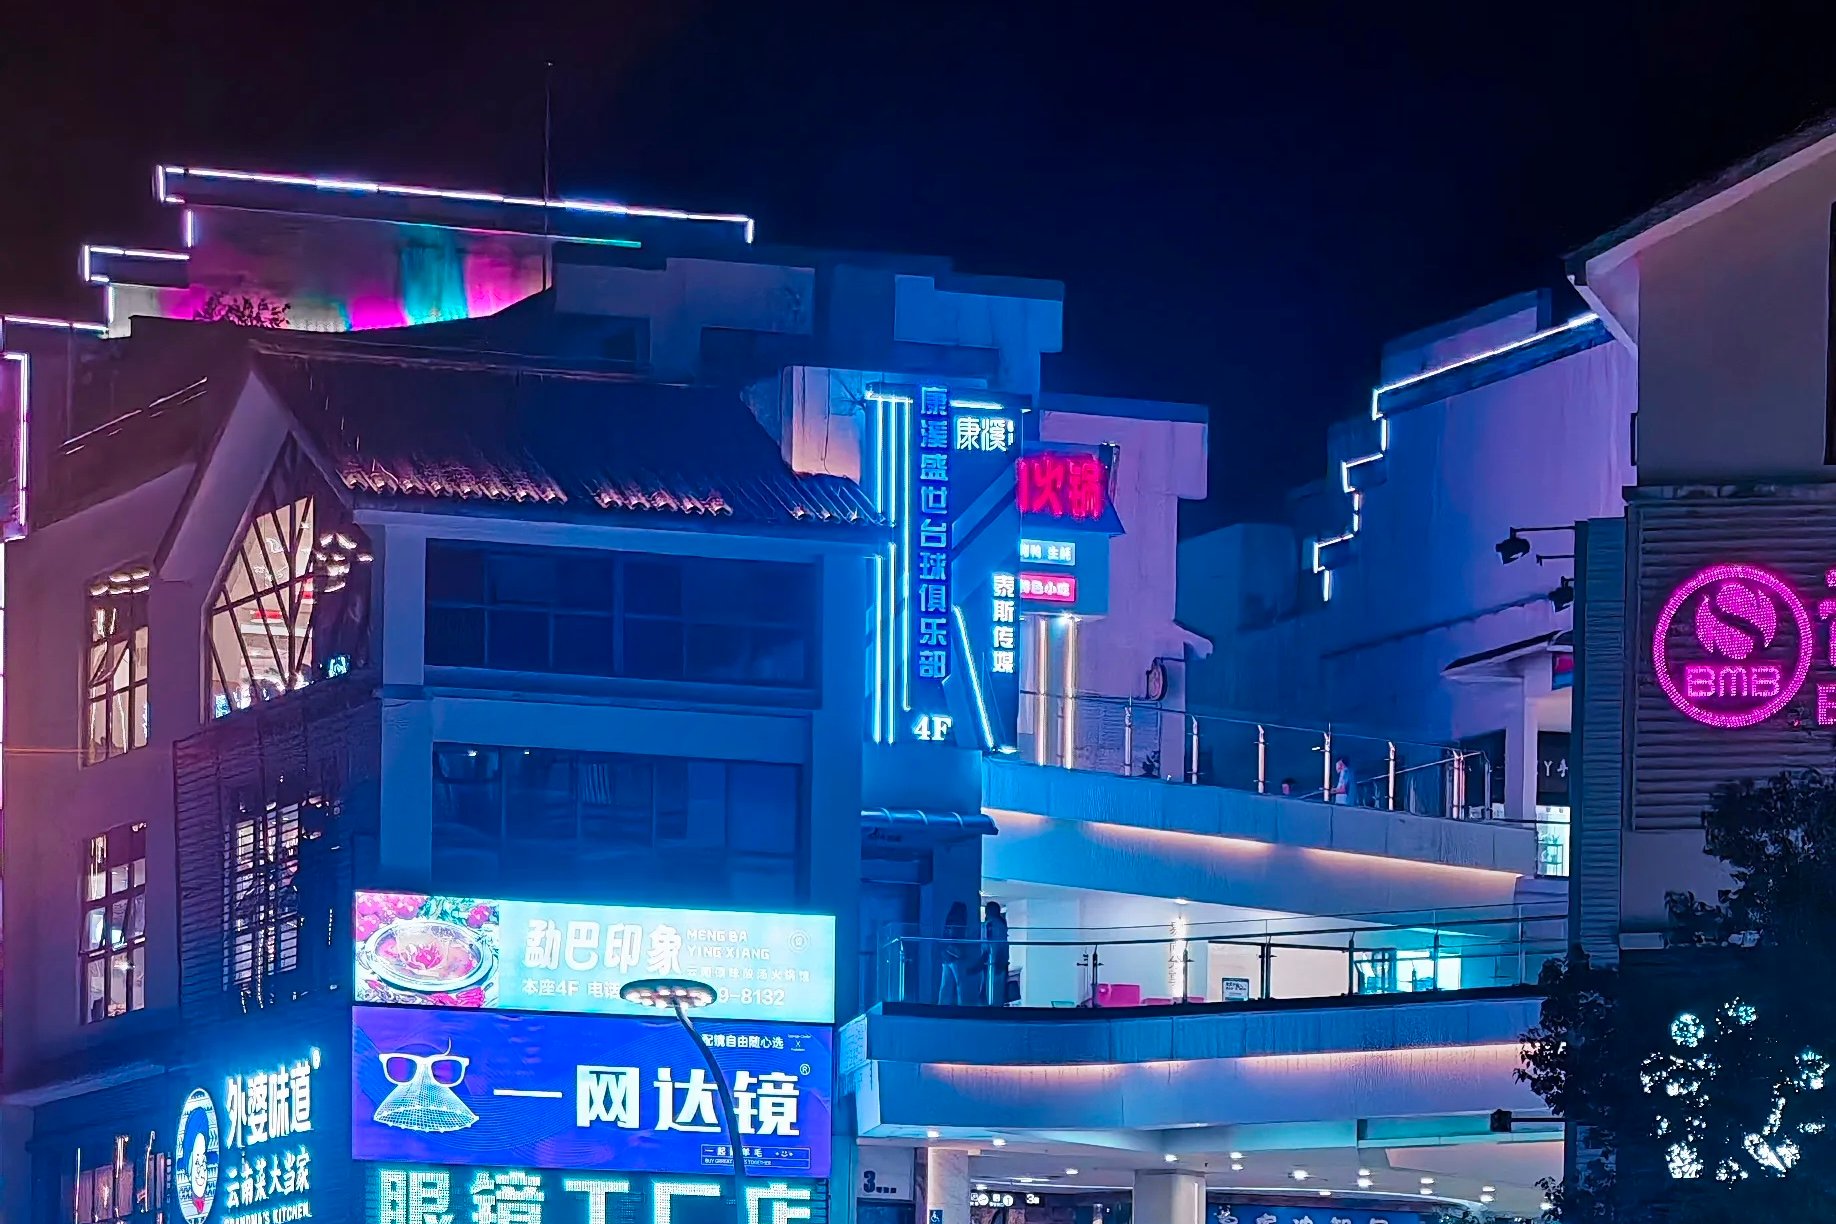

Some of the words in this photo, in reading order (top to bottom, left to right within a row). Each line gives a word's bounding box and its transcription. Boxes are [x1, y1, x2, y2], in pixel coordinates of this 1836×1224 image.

[1018, 457, 1102, 519] 火锅
[919, 386, 948, 679] 康溪盛世台球俱乐部
[1686, 665, 1781, 697] BMB
[913, 716, 952, 740] 4F
[523, 919, 684, 976] 勐巴印象
[687, 929, 726, 942] MENG
[728, 931, 748, 943] BA
[687, 945, 721, 959] YING
[725, 947, 770, 960] XIANG
[718, 987, 785, 1006] 9-8132
[702, 1034, 784, 1049] 配镜自由随心选
[226, 1060, 313, 1149] 外婆味道
[493, 1064, 800, 1136] 一网达镜
[704, 1146, 762, 1158] 一起羊毛
[227, 1146, 312, 1208] 云南菜大当家
[272, 1202, 312, 1224] KITCHEN
